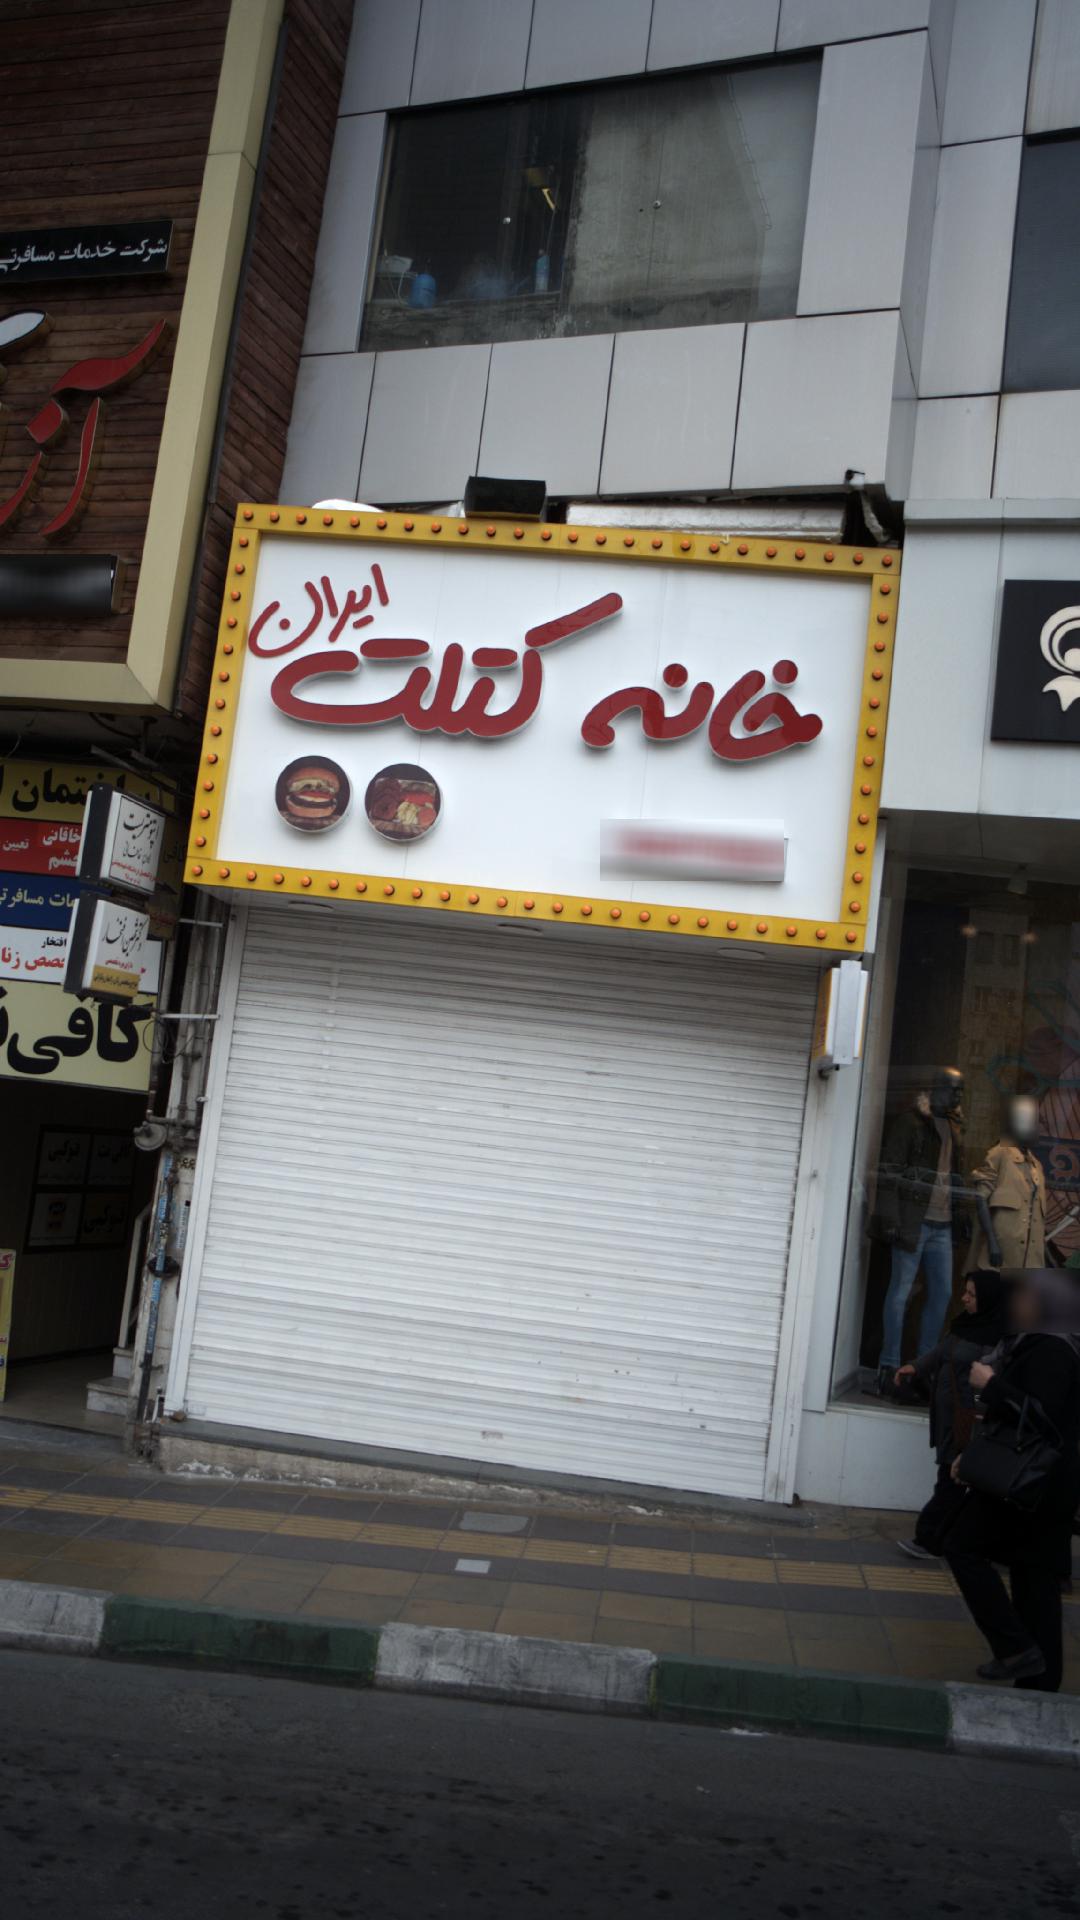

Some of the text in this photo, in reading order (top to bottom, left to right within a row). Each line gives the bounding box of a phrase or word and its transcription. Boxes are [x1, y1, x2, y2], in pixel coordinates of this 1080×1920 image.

[58, 240, 117, 261] خدمات
[119, 238, 168, 262] شرکت
[247, 563, 390, 658] ایران
[269, 592, 824, 762] خانه کتلت
[7, 985, 154, 1075] کافی
